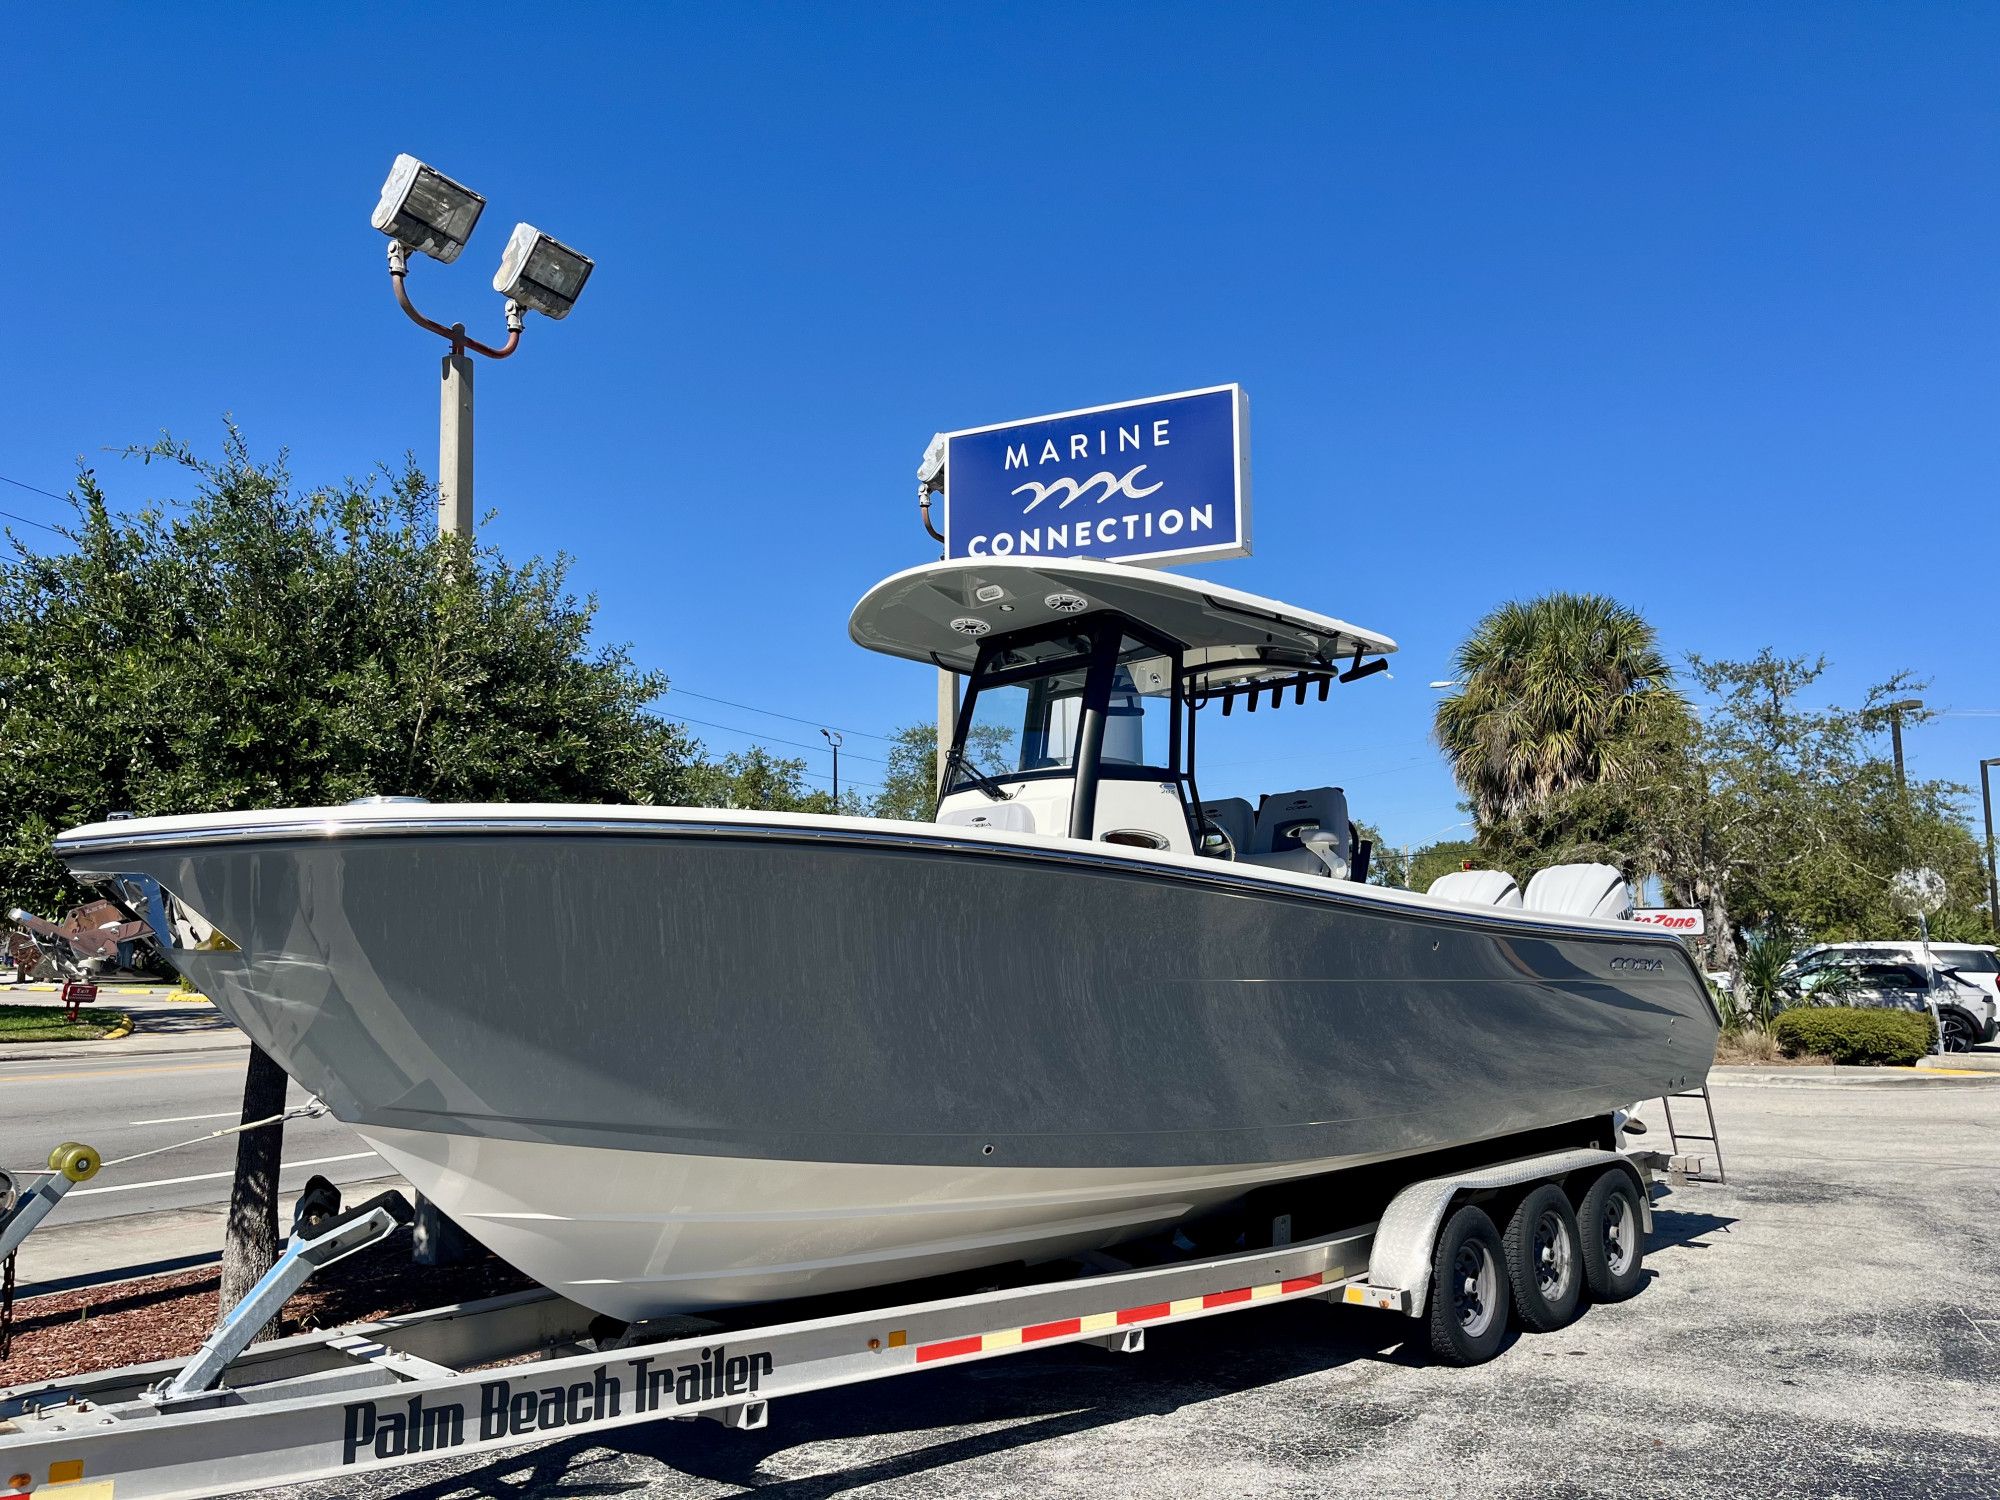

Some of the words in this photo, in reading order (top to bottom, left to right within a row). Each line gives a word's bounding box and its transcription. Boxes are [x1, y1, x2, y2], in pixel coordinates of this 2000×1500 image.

[1004, 419, 1170, 470] MARINE
[967, 503, 1213, 558] CONNECTION
[1610, 957, 1665, 971] COBIA
[342, 1393, 465, 1465] Palm
[479, 1364, 622, 1442] Beach
[627, 1345, 774, 1414] Trailer
